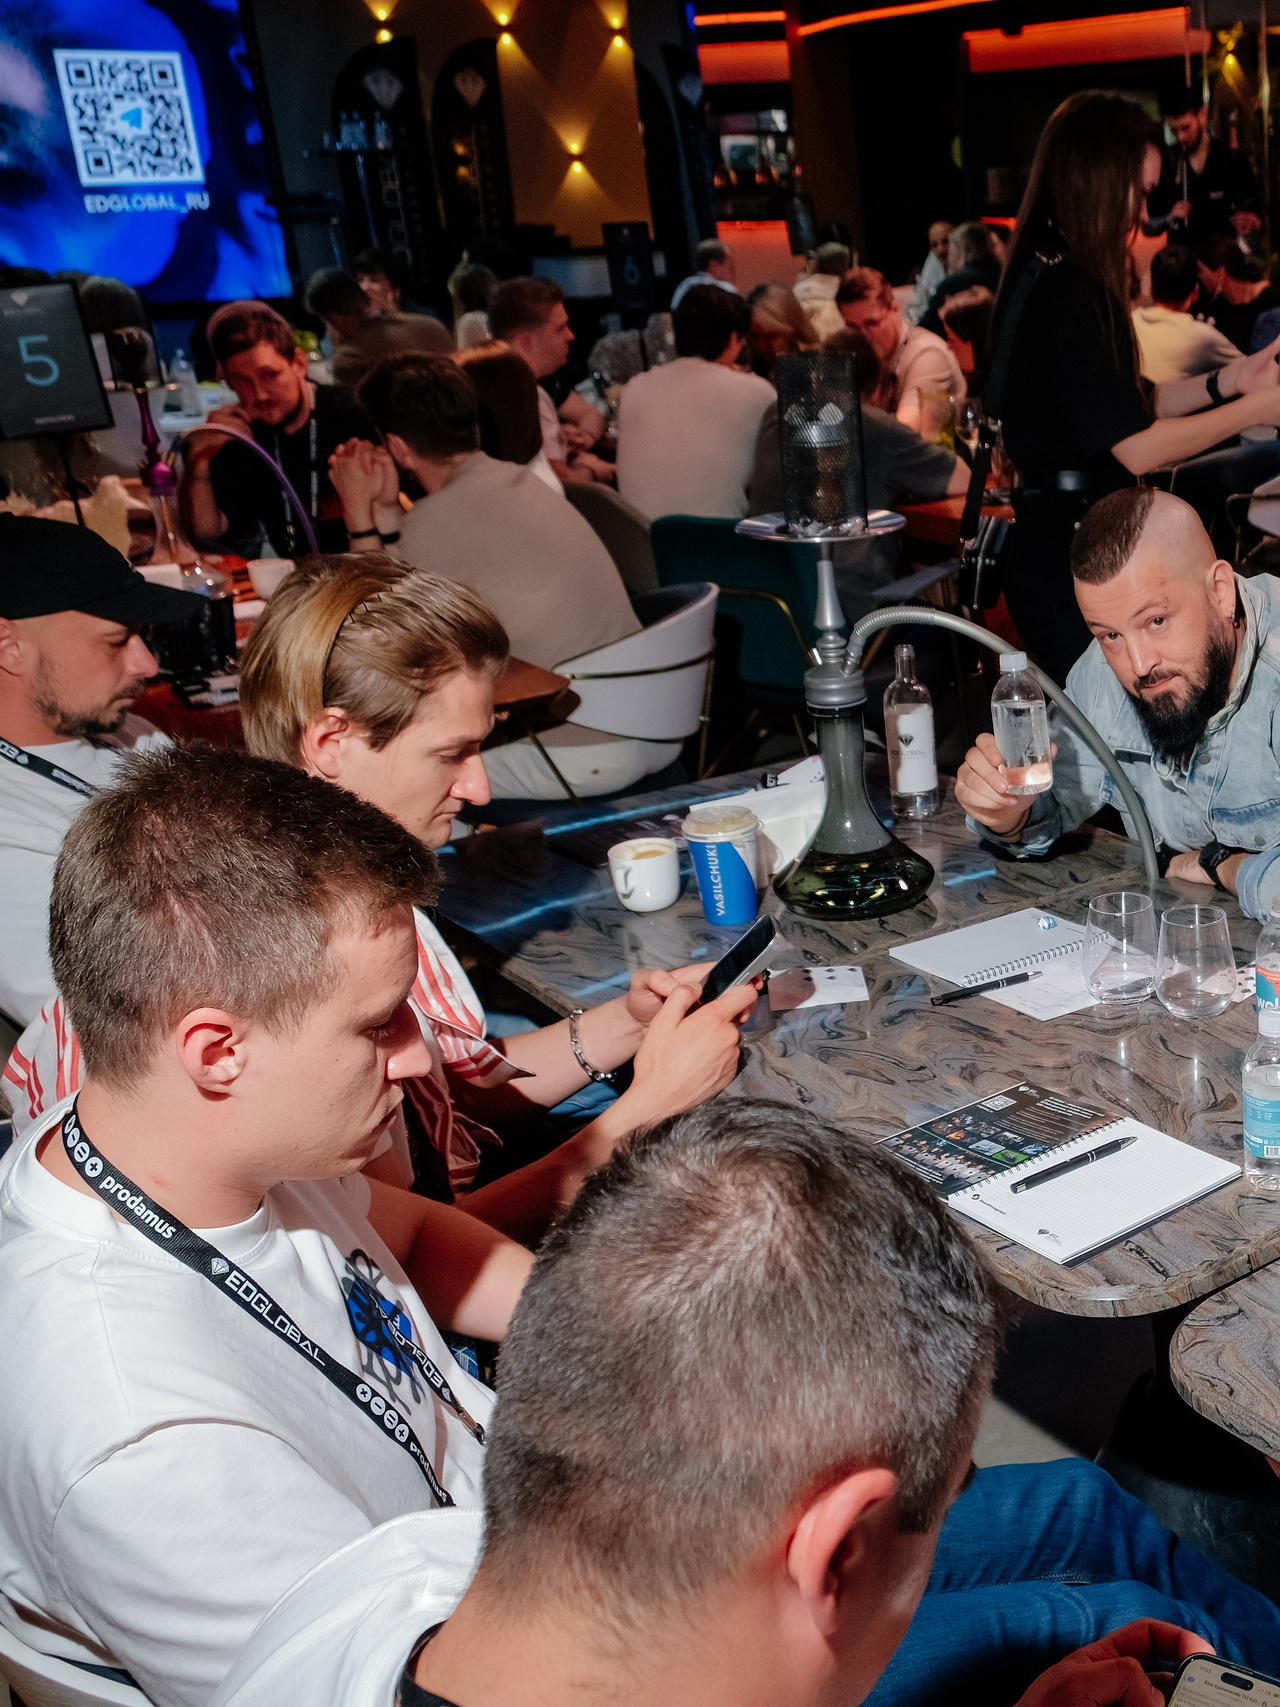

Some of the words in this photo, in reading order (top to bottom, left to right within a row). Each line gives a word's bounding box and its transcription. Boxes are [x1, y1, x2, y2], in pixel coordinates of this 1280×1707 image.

[623, 253, 641, 287] 6
[18, 334, 60, 387] 5
[705, 844, 726, 917] VASILCHUKI
[99, 1175, 177, 1240] prodamus
[224, 1270, 326, 1367] EDGLOBAL
[410, 1441, 448, 1503] prodamus
